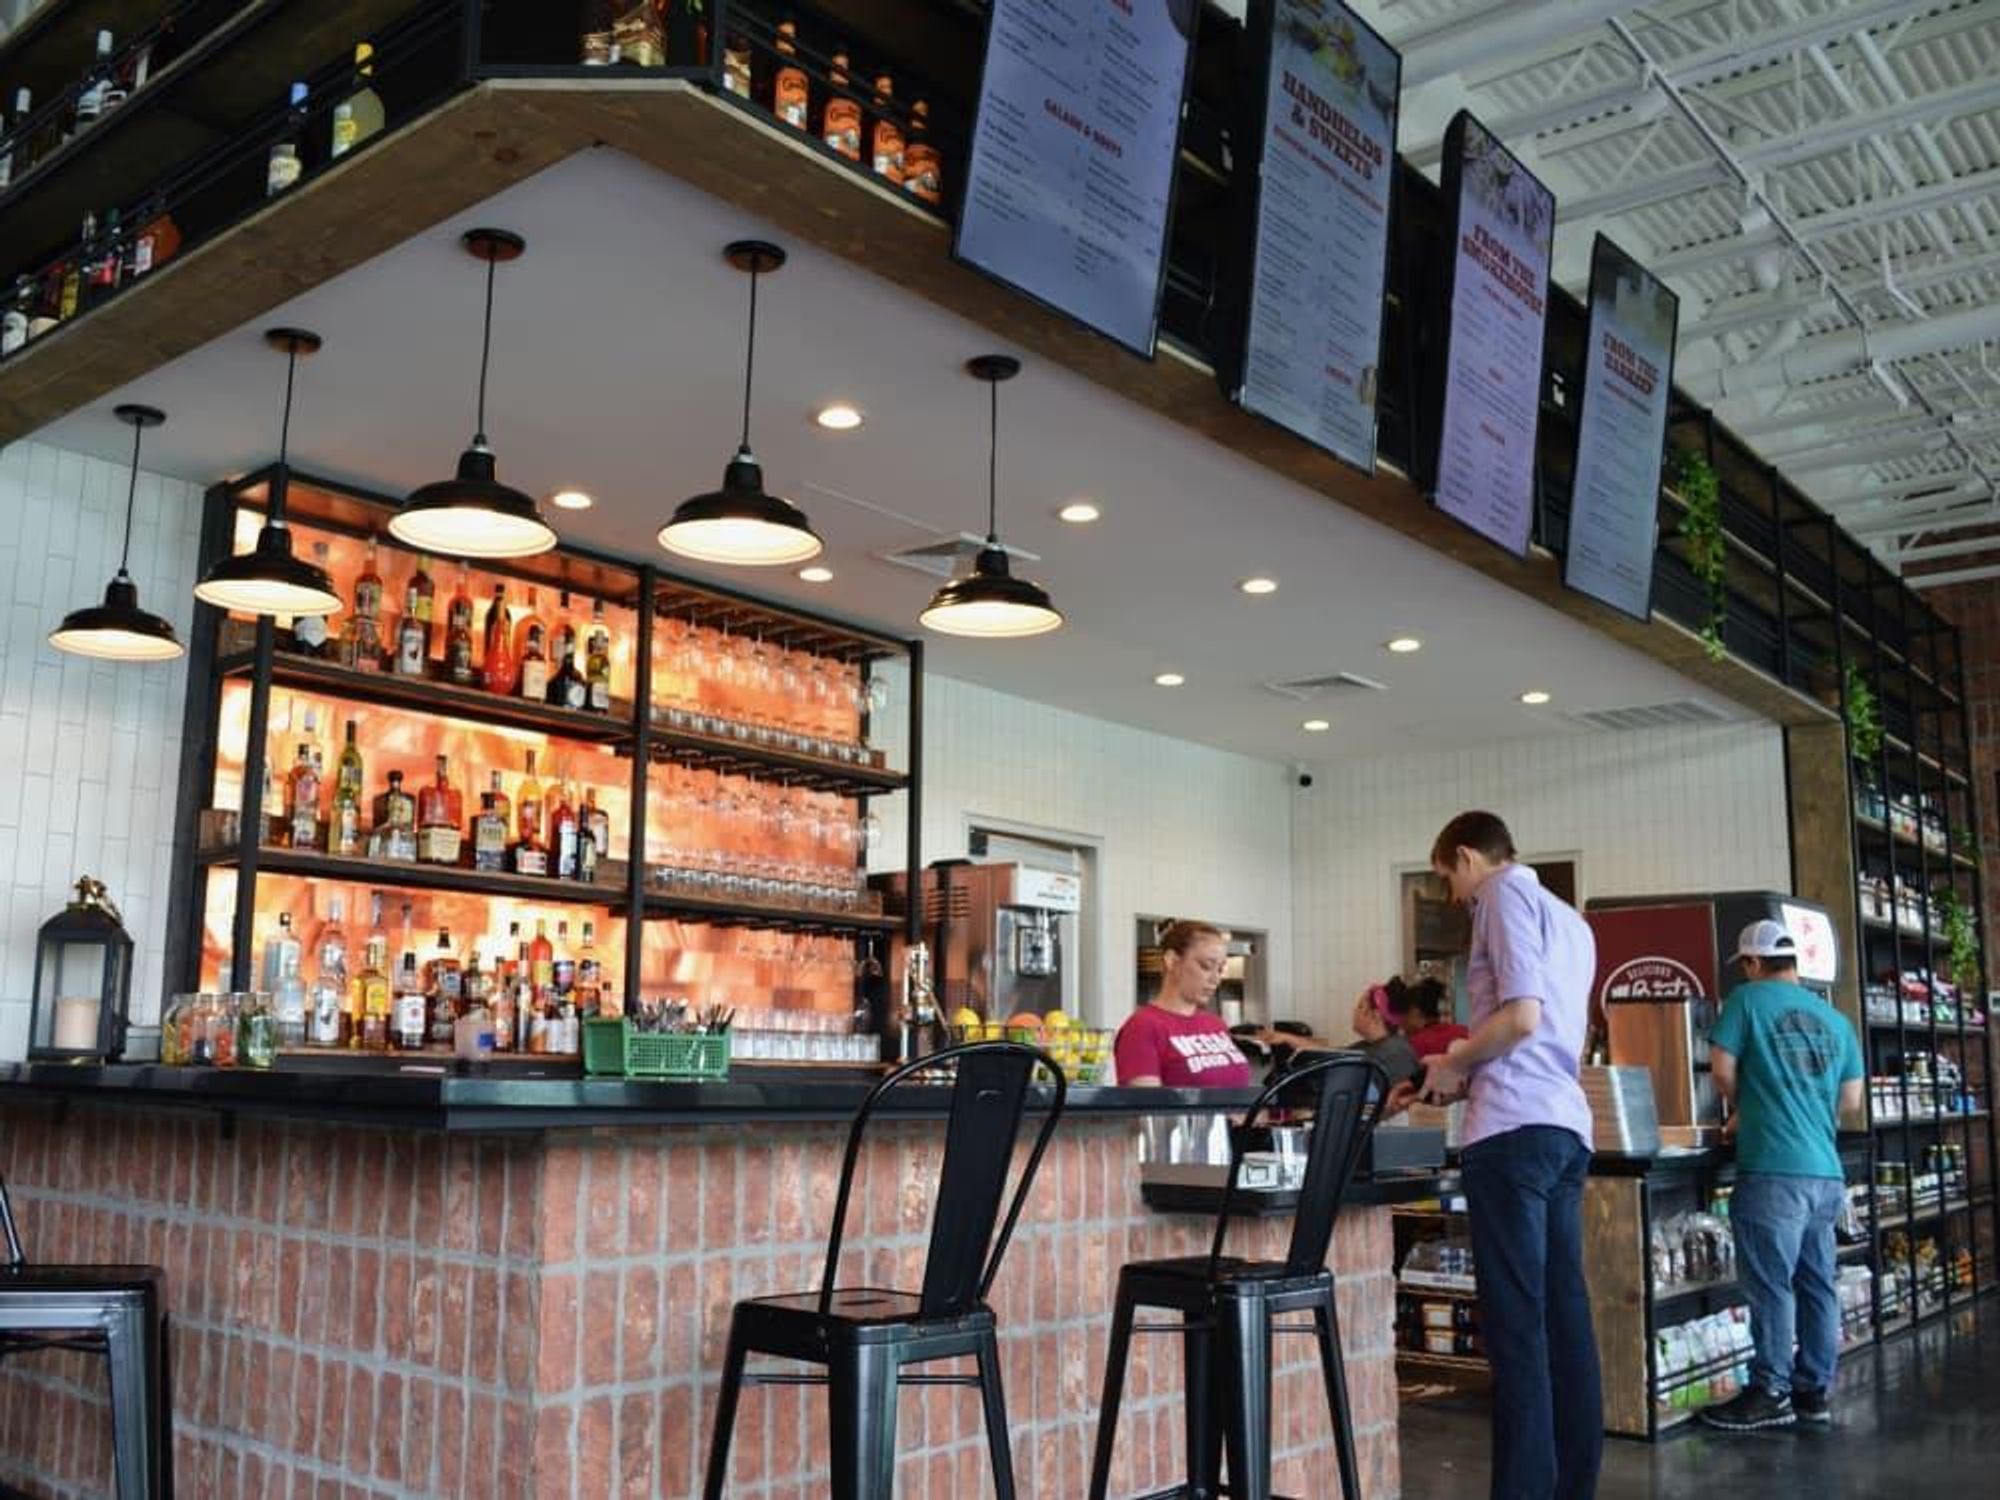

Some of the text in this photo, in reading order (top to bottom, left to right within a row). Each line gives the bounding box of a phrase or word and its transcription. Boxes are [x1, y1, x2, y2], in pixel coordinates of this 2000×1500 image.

[1283, 70, 1382, 166] HANDHELDS
[1291, 103, 1305, 128] &
[1310, 116, 1373, 180] SWEETS
[1474, 224, 1537, 289] FROM THE
[1603, 331, 1659, 383] FROM THE
